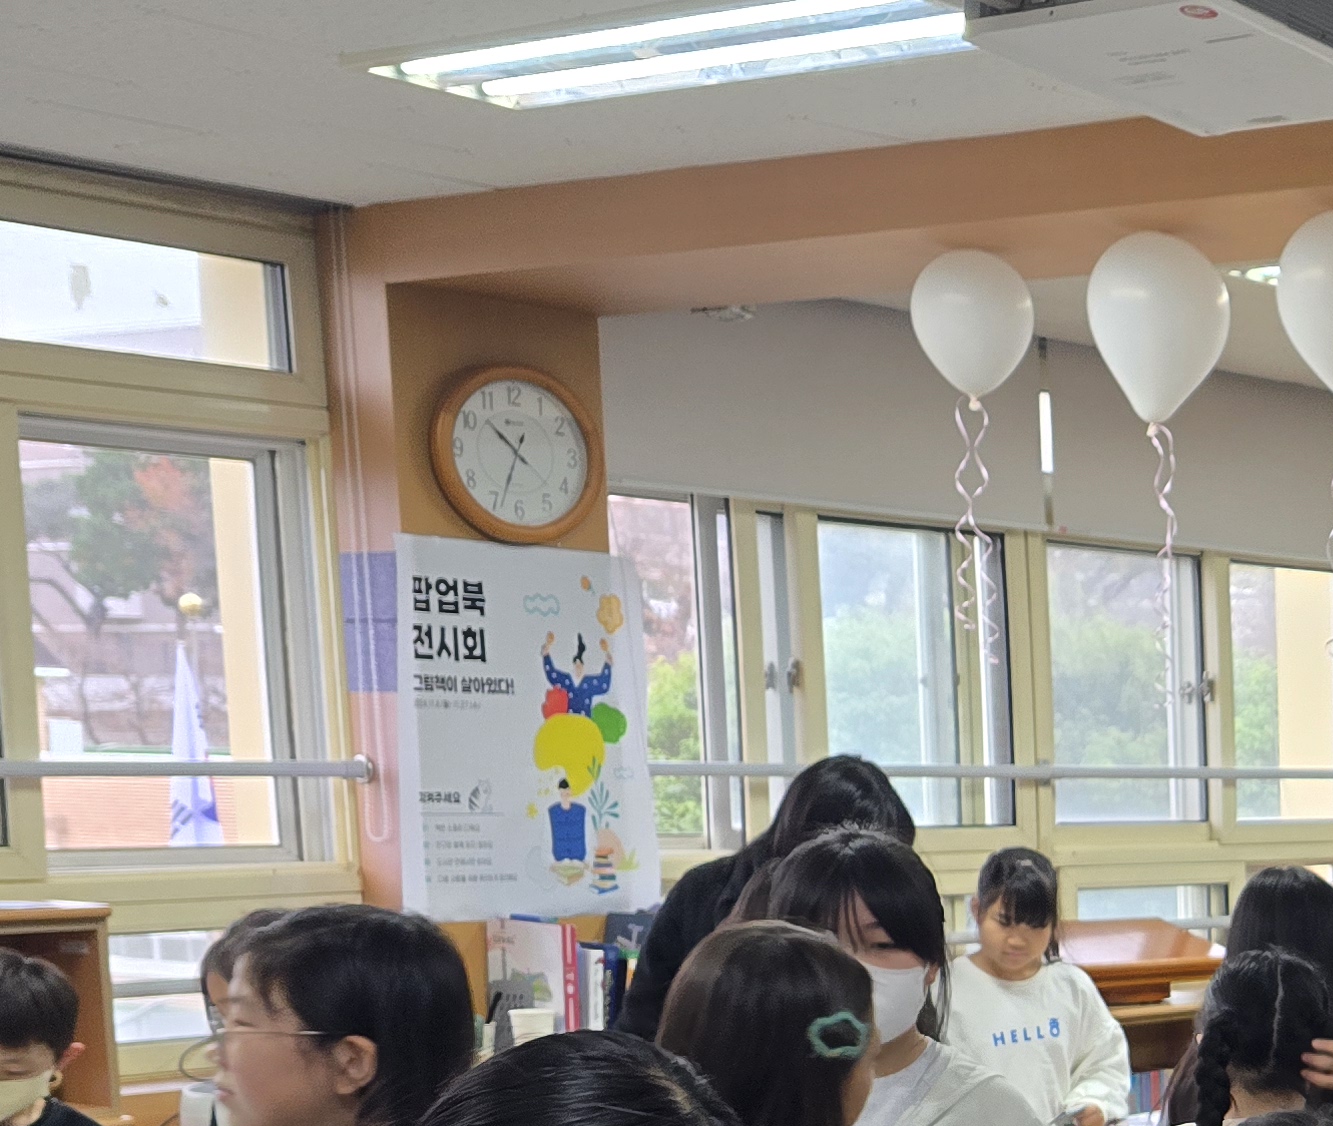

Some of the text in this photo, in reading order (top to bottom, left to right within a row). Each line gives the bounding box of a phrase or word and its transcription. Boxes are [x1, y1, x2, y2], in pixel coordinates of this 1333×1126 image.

[480, 390, 494, 410] 11
[506, 387, 522, 407] 12
[537, 396, 543, 415] 1
[462, 411, 478, 431] 10
[555, 417, 566, 435] 2
[452, 438, 464, 457] 9
[567, 448, 578, 468] 3
[466, 469, 476, 487] 8
[559, 477, 569, 494] 4
[490, 491, 499, 510] 7
[513, 500, 525, 520] 6
[542, 493, 553, 513] 5
[412, 575, 486, 616] 팝업북
[412, 624, 487, 663] 전시회
[412, 676, 458, 693] 그림책이
[993, 1019, 1061, 1047] HELLO
